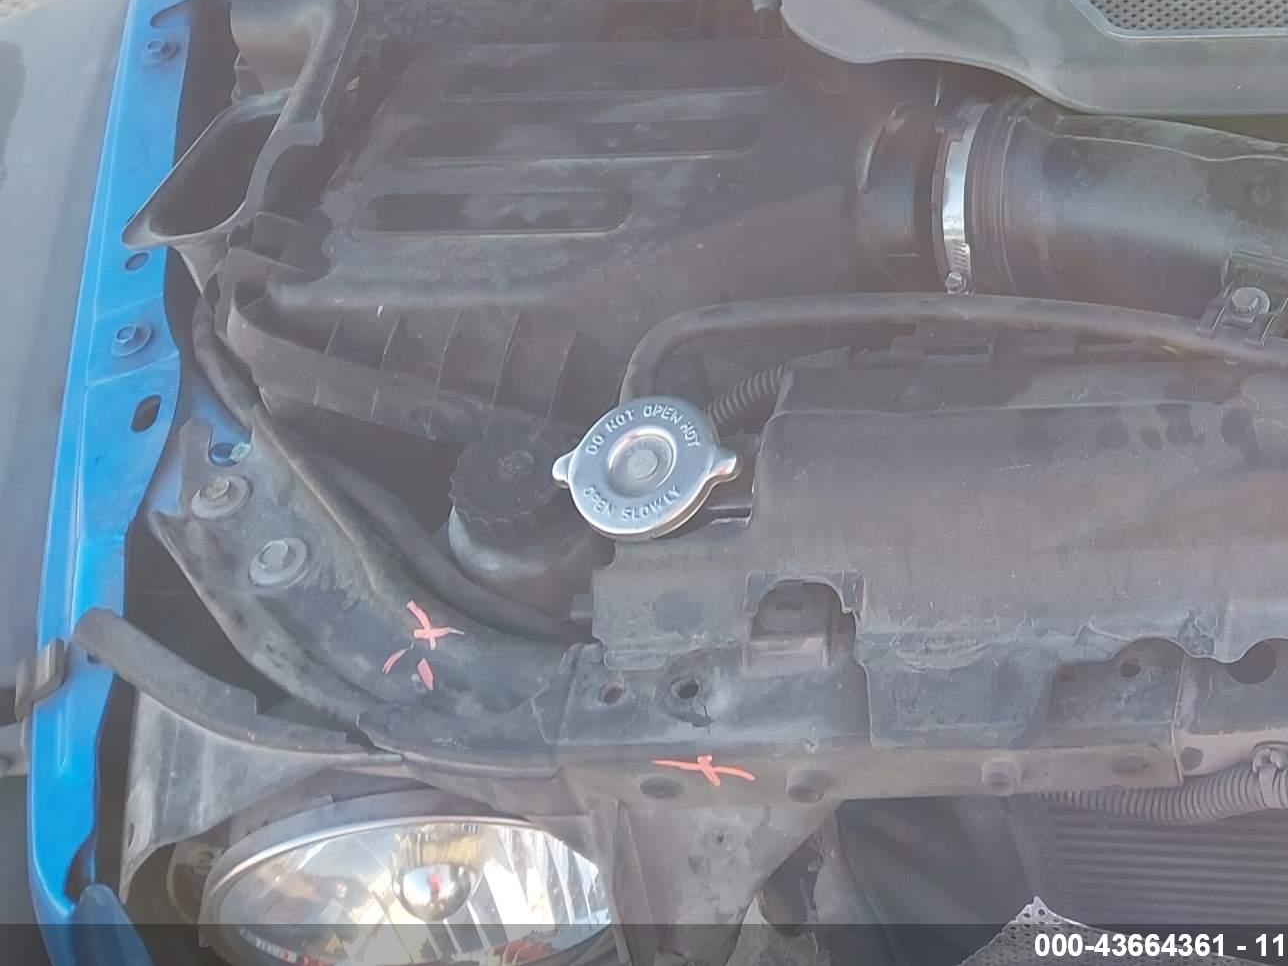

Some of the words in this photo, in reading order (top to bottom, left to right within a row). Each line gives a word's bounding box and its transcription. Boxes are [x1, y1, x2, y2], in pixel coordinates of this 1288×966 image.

[585, 435, 604, 456] DO
[605, 409, 635, 433] NOT
[643, 403, 683, 424] OPEN
[680, 421, 701, 448] HOT
[583, 484, 614, 518] OPEN
[622, 484, 681, 521] SLOWLY
